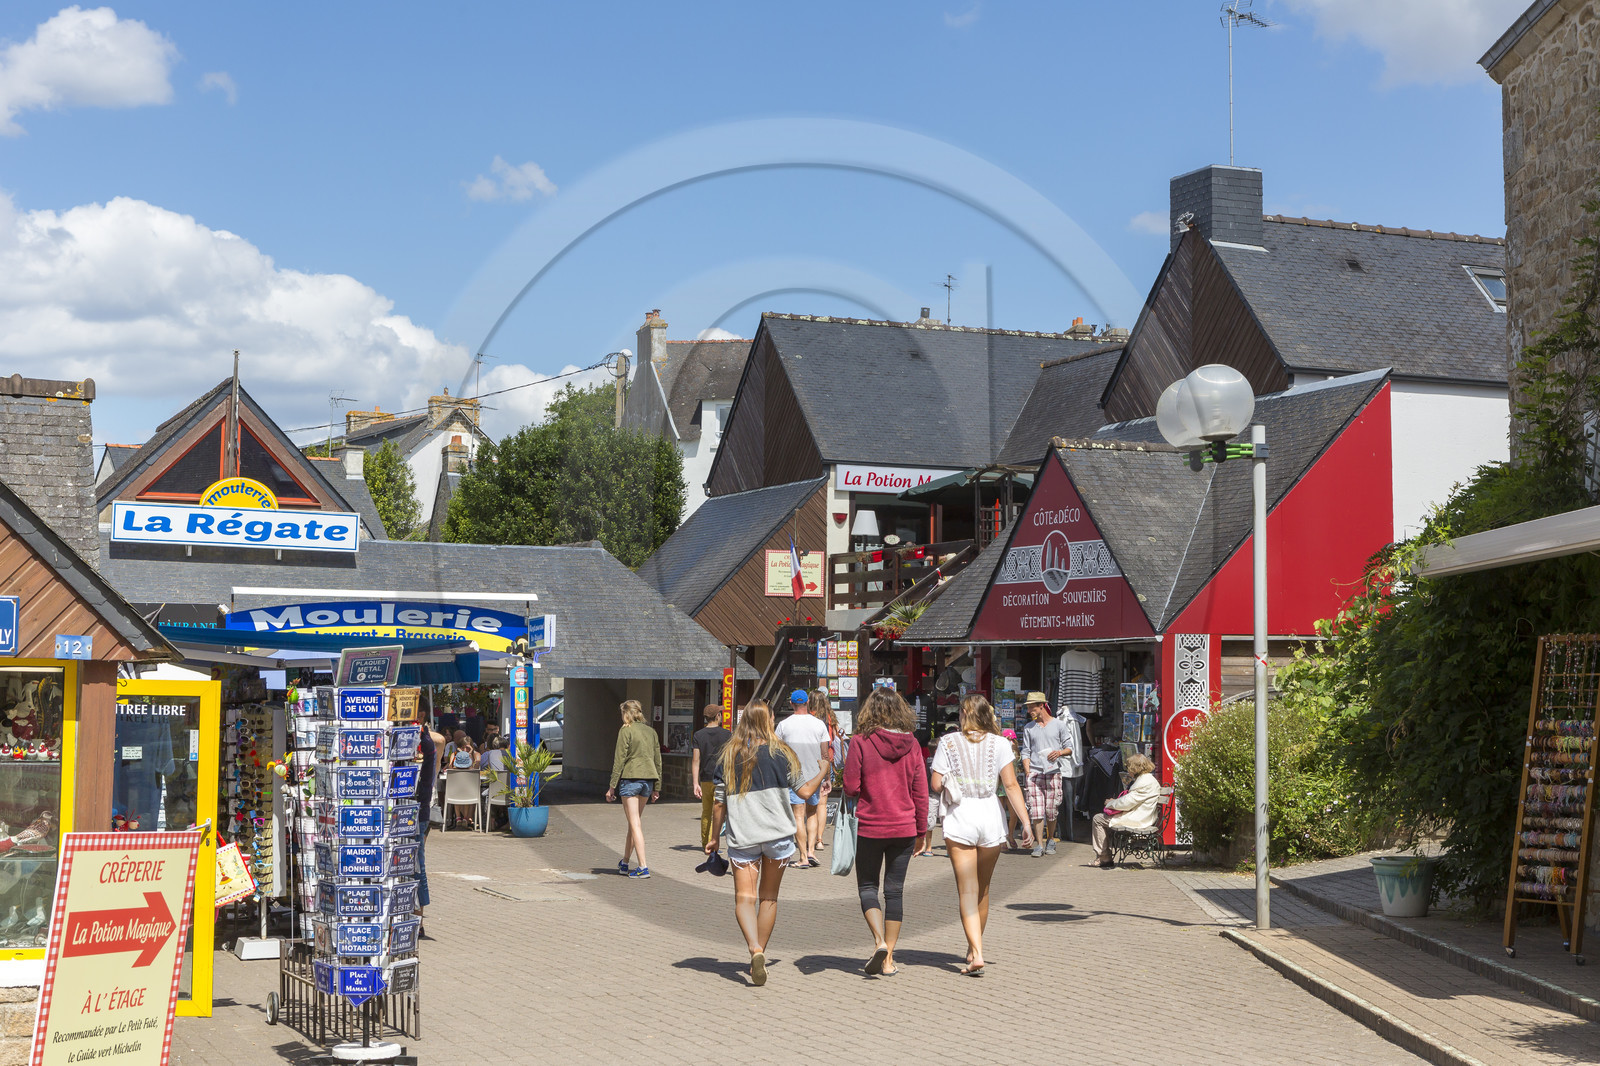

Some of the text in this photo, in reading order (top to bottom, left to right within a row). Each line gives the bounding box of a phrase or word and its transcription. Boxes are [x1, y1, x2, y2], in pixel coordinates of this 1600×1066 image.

[844, 471, 861, 486] La
[866, 472, 912, 488] Potion
[206, 482, 271, 509] moulerie
[122, 510, 349, 543] La Régate
[1002, 588, 1107, 607] DÉCORATION SOUVENIRS
[249, 602, 503, 633] Moulerie
[64, 640, 82, 654] 12
[151, 704, 186, 716] LIBRE
[347, 746, 376, 754] PARIS
[99, 854, 166, 884] CRÊPERIE
[393, 904, 410, 912] SESTE
[72, 916, 172, 946] La Potion Magique
[81, 990, 91, 1015] À
[52, 1016, 158, 1044] Recommandée par Le Petit Futé,
[68, 1040, 142, 1064] le Guide vert Michelin
